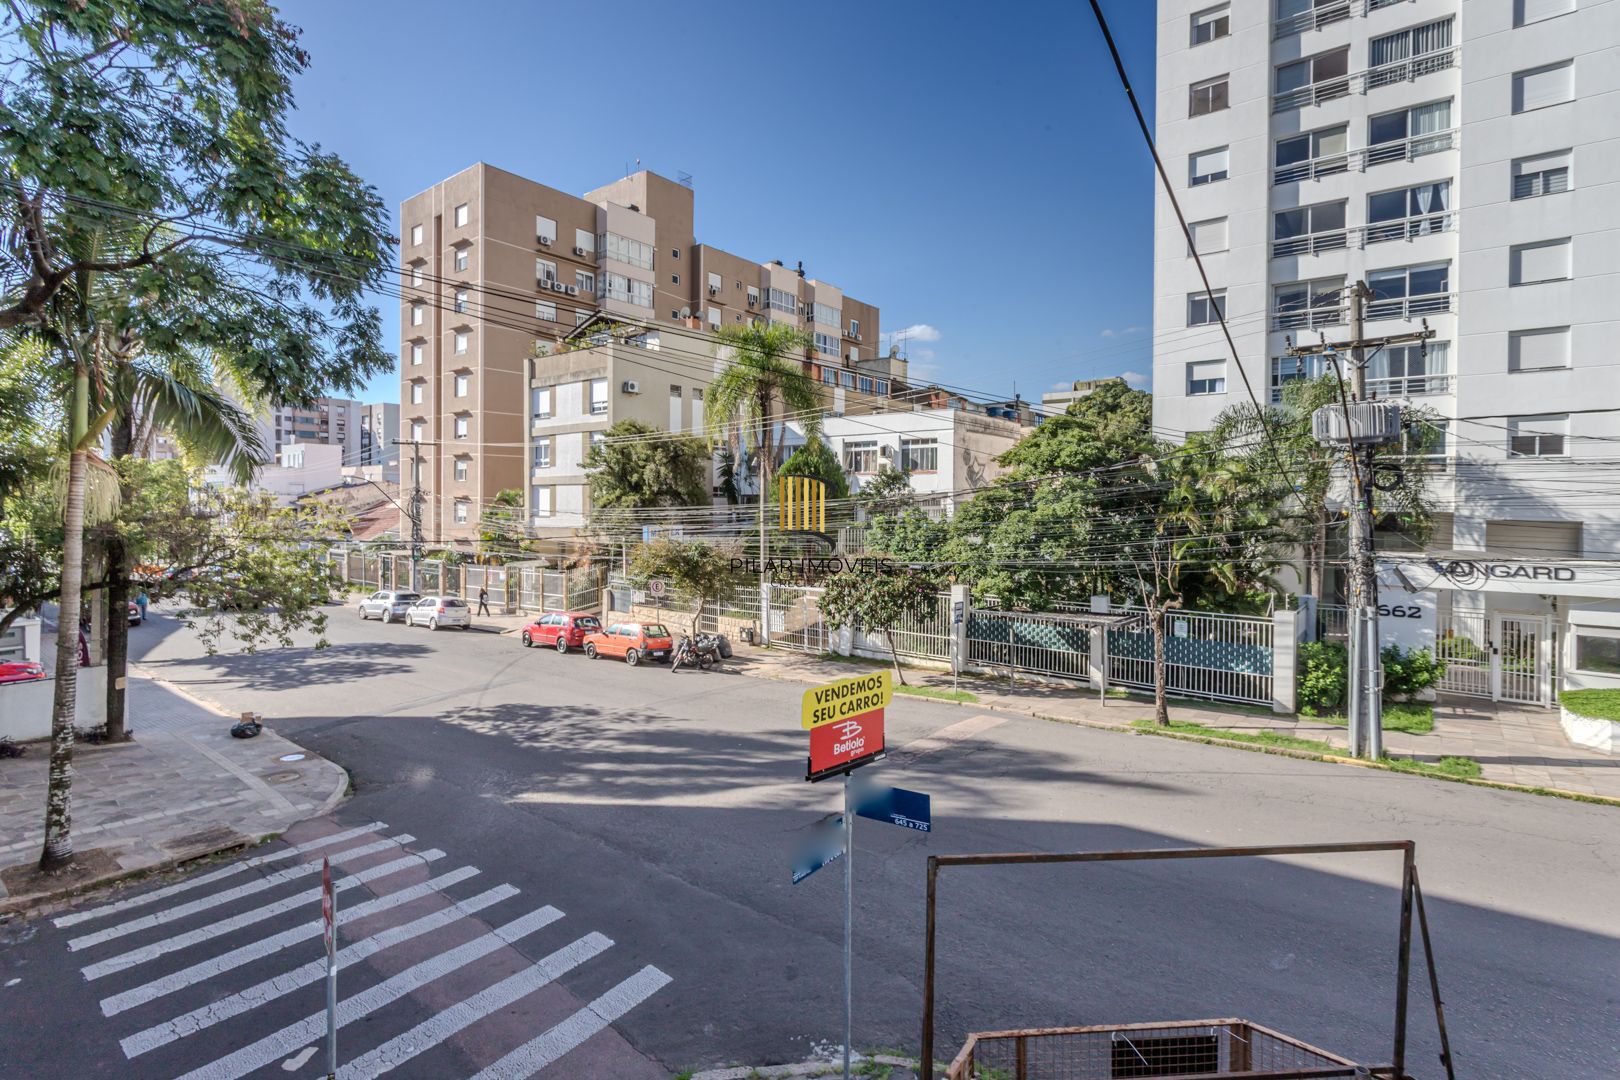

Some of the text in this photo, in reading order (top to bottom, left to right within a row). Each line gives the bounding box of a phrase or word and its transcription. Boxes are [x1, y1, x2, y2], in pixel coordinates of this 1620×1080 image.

[815, 676, 882, 704] VENDEMOS
[813, 692, 884, 724] SEU CARRO!
[915, 822, 928, 831] 725
